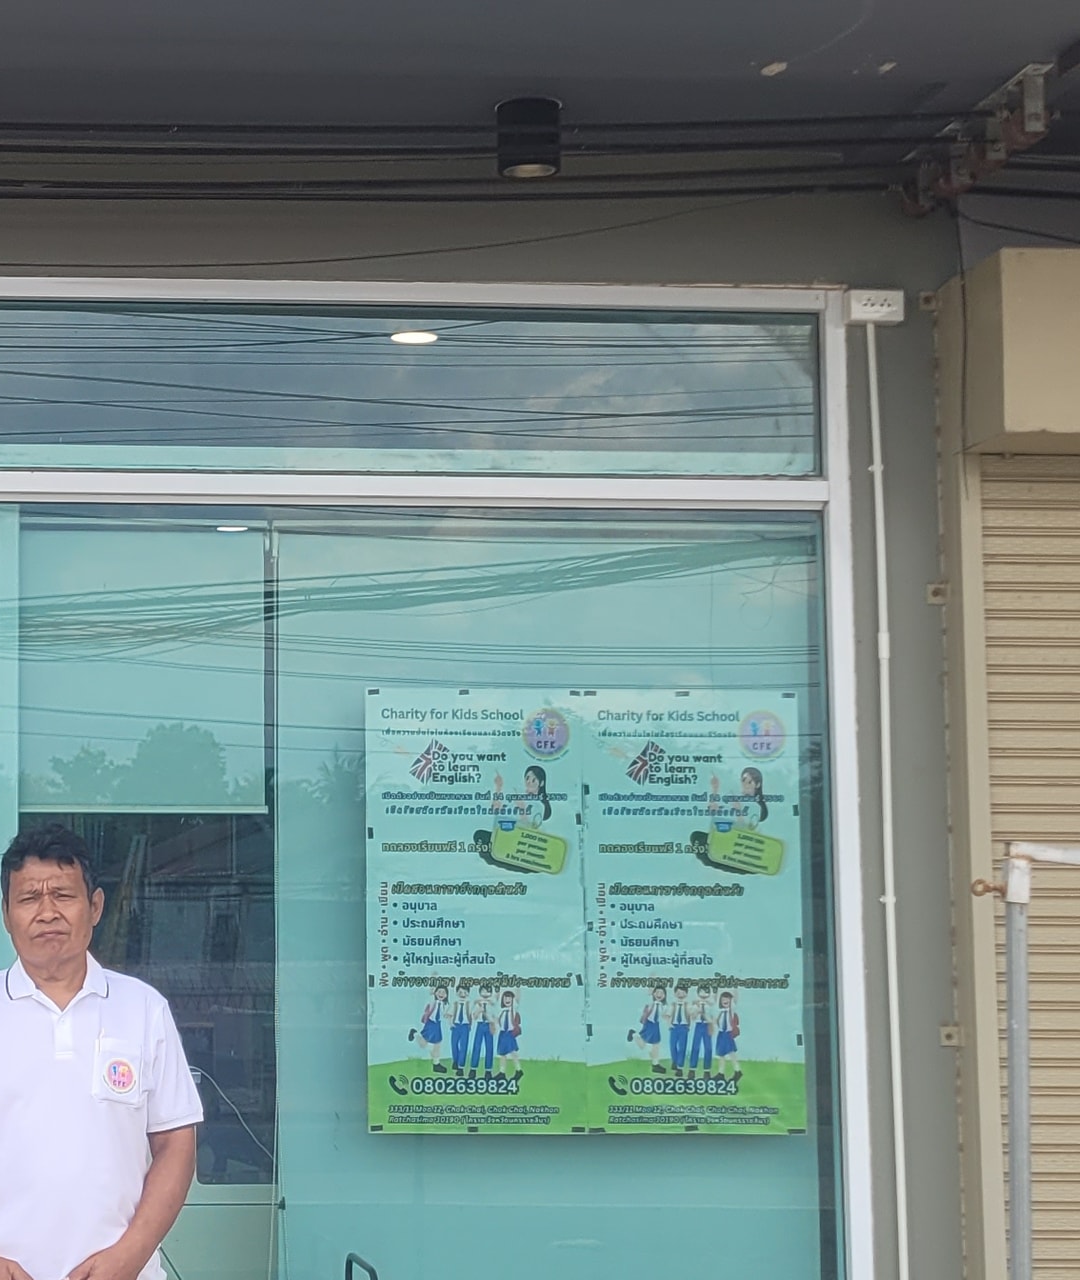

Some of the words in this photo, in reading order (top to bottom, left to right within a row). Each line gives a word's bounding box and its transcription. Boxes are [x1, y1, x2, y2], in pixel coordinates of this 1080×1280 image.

[381, 708, 427, 723] Charity
[429, 707, 449, 721] for
[451, 708, 478, 721] Kids
[480, 708, 524, 721] School
[597, 710, 643, 724] Charity
[646, 709, 665, 722] for
[667, 710, 695, 722] Kids
[696, 710, 740, 722] School
[536, 739, 556, 750] CFK
[431, 751, 449, 762] Do
[451, 752, 474, 764] you
[476, 752, 507, 762] want
[648, 752, 665, 763] Do
[667, 753, 690, 765] you
[693, 753, 723, 763] want
[448, 761, 480, 772] learn
[664, 763, 696, 774] learn
[432, 773, 482, 785] English?
[648, 774, 698, 787] English?
[382, 840, 458, 853] ทดลองเรียนฟรี
[402, 901, 438, 914] อนุบาล
[619, 901, 655, 915] อนุบาล
[402, 918, 466, 929] ประถมศึกษา
[619, 918, 683, 930] ประถมศึกษา
[402, 935, 462, 947] มัธยมศึกษา
[620, 936, 680, 948] มัธยมศึกษา
[402, 950, 496, 968] ผู้ใหญ่และผู้ที่สนใจ
[620, 951, 714, 968] ผู้ใหญ่และผู้ที่สนใจ
[412, 1078, 519, 1094] 0802639824
[630, 1078, 737, 1094] 0802639824
